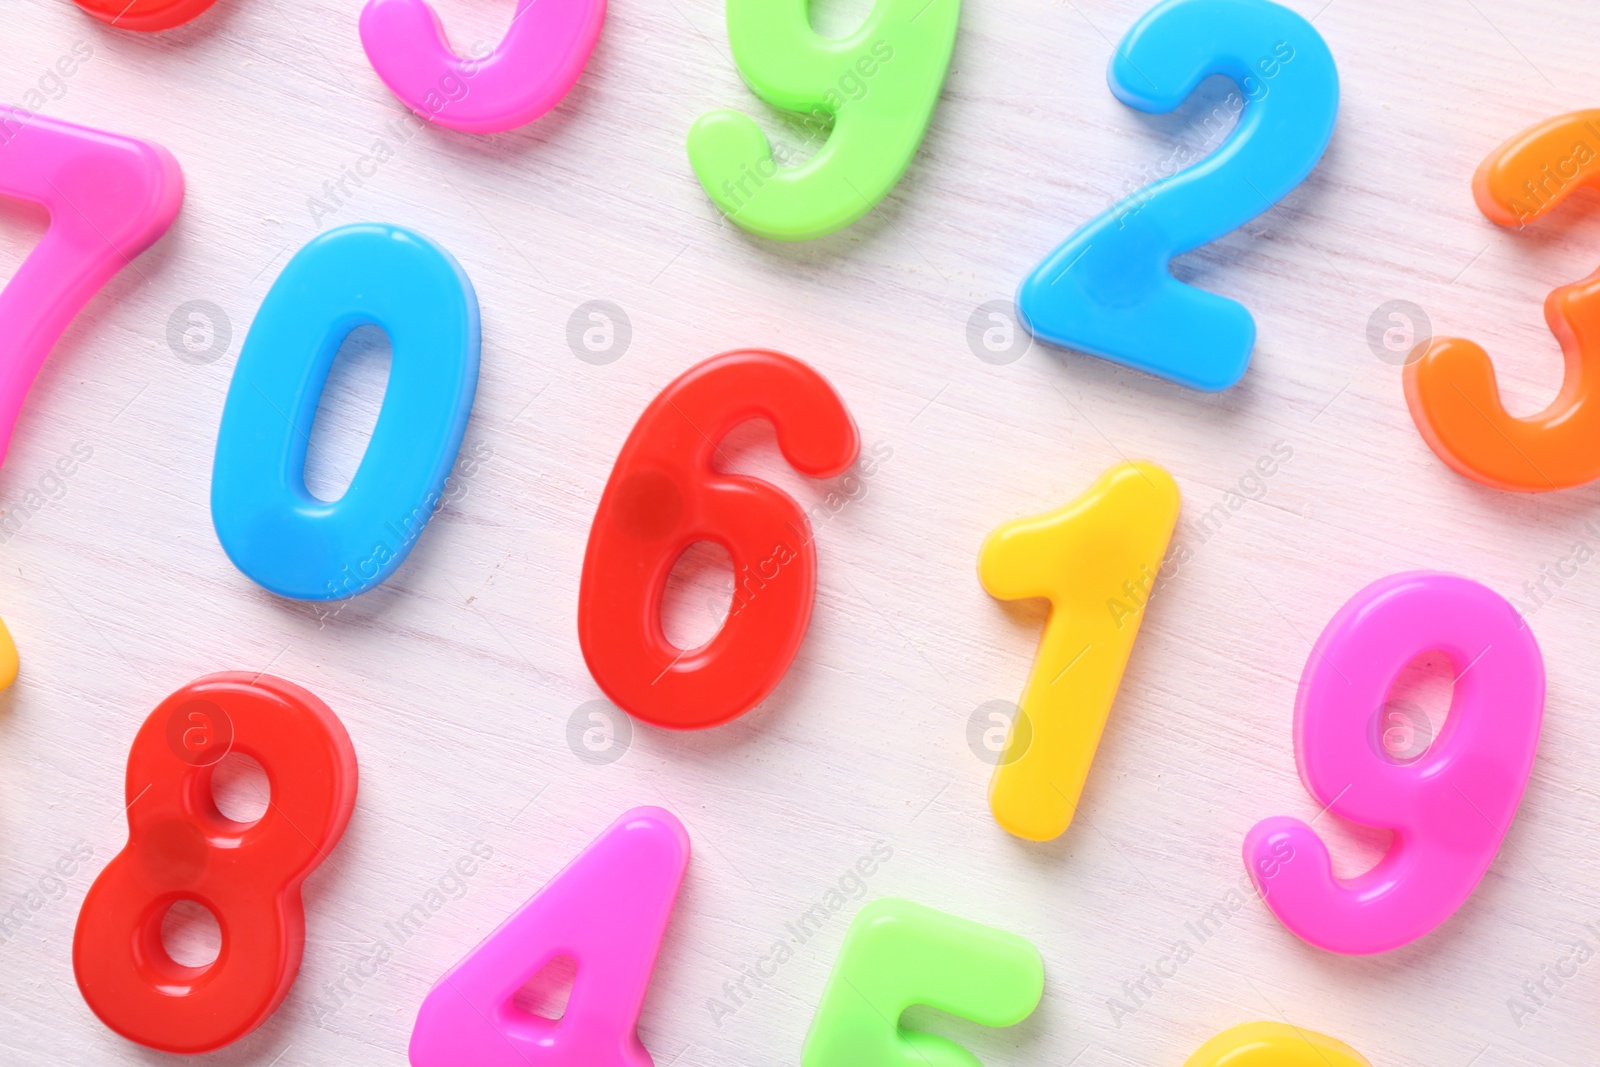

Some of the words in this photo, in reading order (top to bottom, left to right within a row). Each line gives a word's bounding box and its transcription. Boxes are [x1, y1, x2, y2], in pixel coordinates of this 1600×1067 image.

[1016, 0, 1339, 392] 2
[211, 223, 481, 602] 0
[578, 350, 860, 731] 6
[977, 461, 1180, 843] 1
[1243, 571, 1545, 956] 9
[72, 671, 358, 1055] 8
[409, 806, 690, 1067] 4
